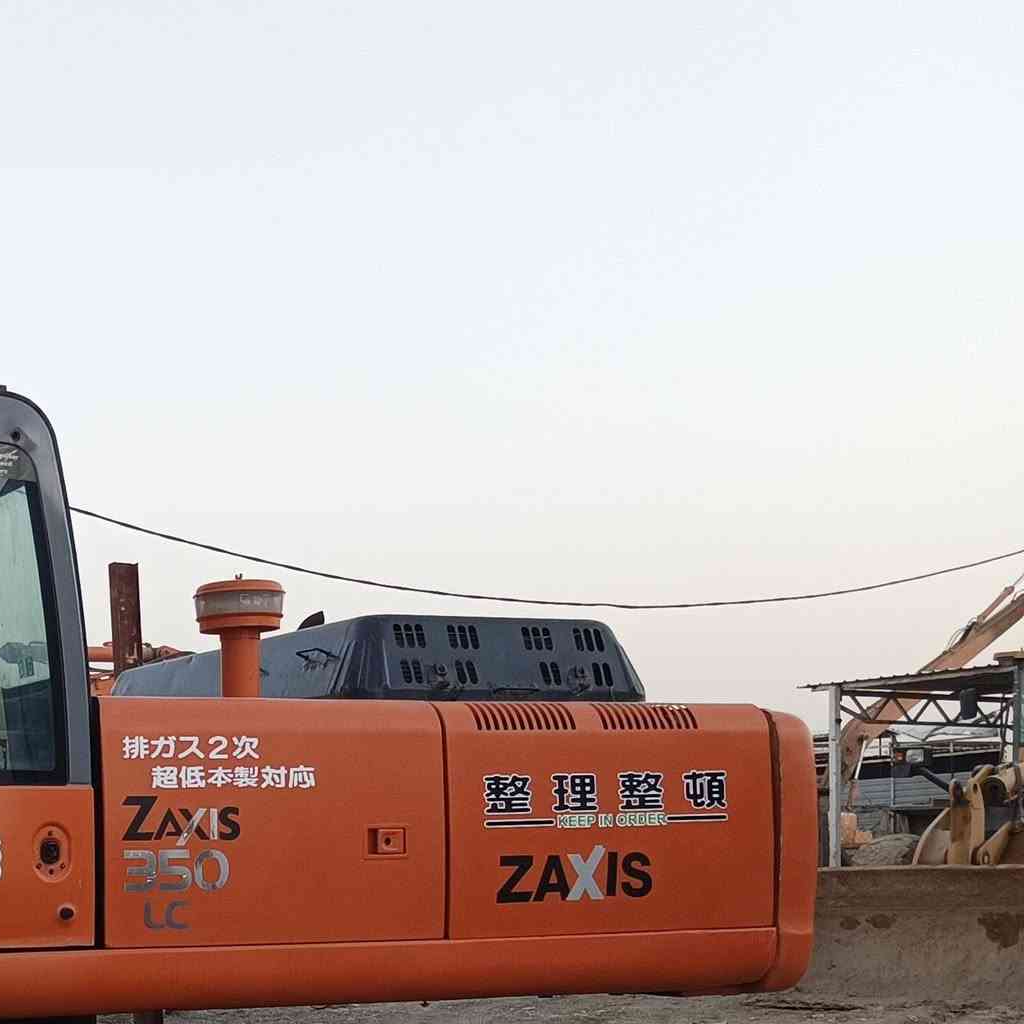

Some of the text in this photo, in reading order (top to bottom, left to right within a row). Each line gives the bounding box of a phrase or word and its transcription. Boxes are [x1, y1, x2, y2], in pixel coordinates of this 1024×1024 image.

[122, 735, 260, 760] 排ガス2次
[121, 795, 241, 846] ZAXIS
[556, 811, 668, 829] KEEP IN ORDER
[123, 849, 231, 892] 350
[495, 845, 653, 904] ZAXIS
[143, 900, 193, 932] LC
